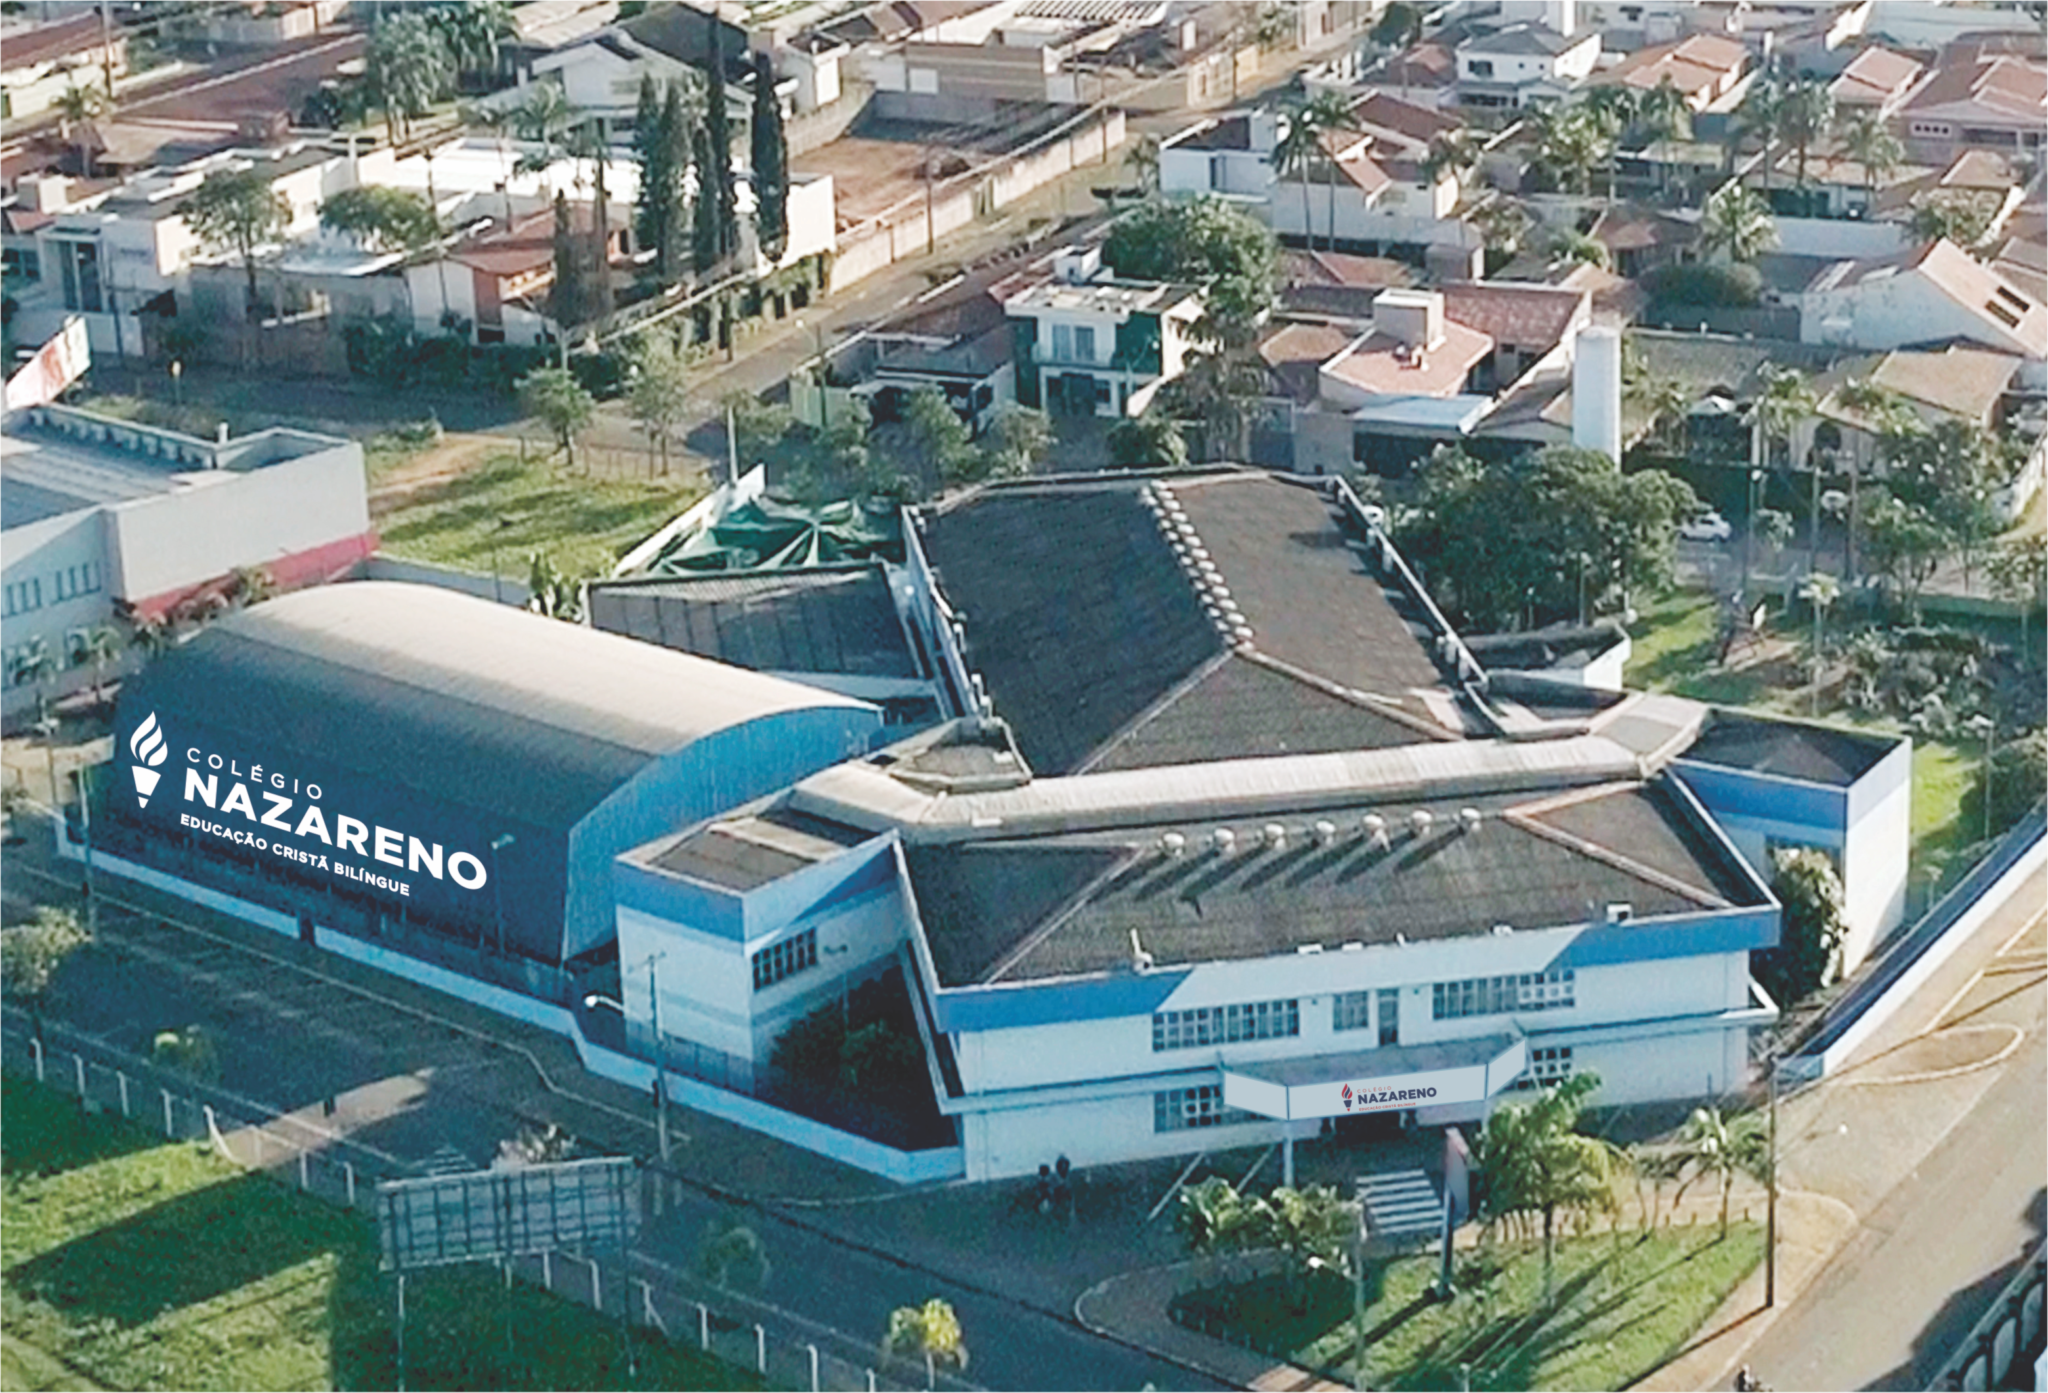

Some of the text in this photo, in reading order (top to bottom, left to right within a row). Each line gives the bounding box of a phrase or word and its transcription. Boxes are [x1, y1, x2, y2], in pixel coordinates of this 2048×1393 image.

[187, 747, 322, 800] COLÉGIO
[180, 812, 410, 897] EDUCAÇÃO CRISTÃ BILÍNGUE
[184, 767, 487, 890] NAZARENO
[1358, 1087, 1437, 1105] NAZARENO
